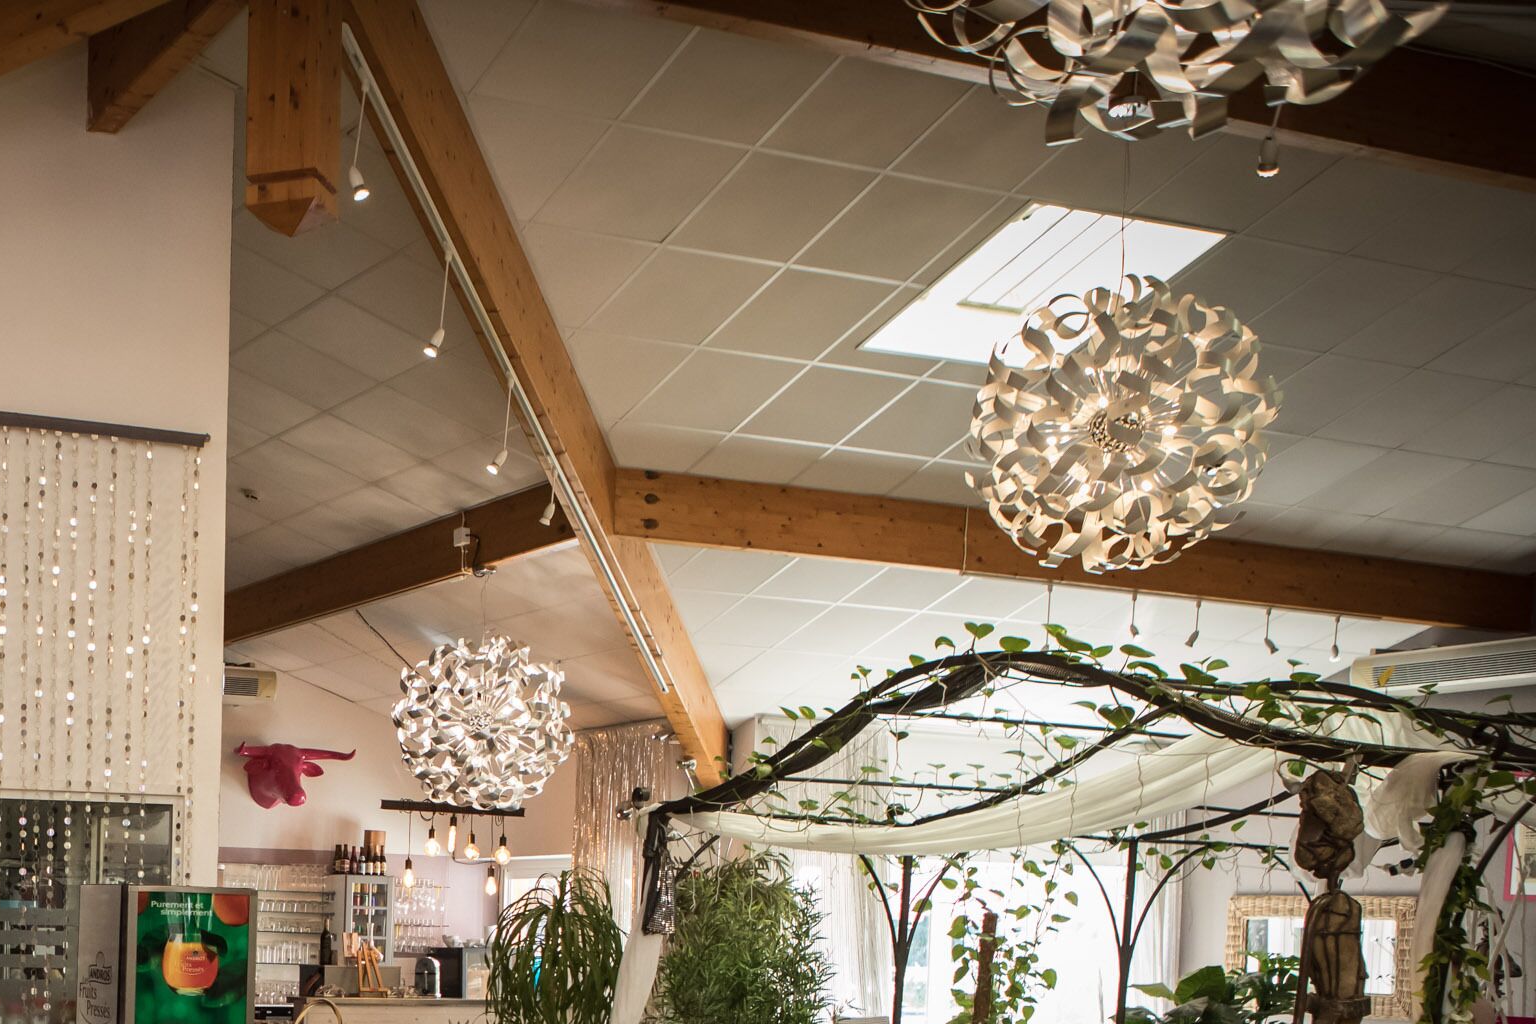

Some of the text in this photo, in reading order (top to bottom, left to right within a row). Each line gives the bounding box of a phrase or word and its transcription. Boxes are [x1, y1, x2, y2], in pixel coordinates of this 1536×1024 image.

[151, 900, 193, 909] Purement
[160, 909, 212, 917] simplement
[89, 967, 111, 982] ANDROS
[79, 982, 98, 1000] Fruits
